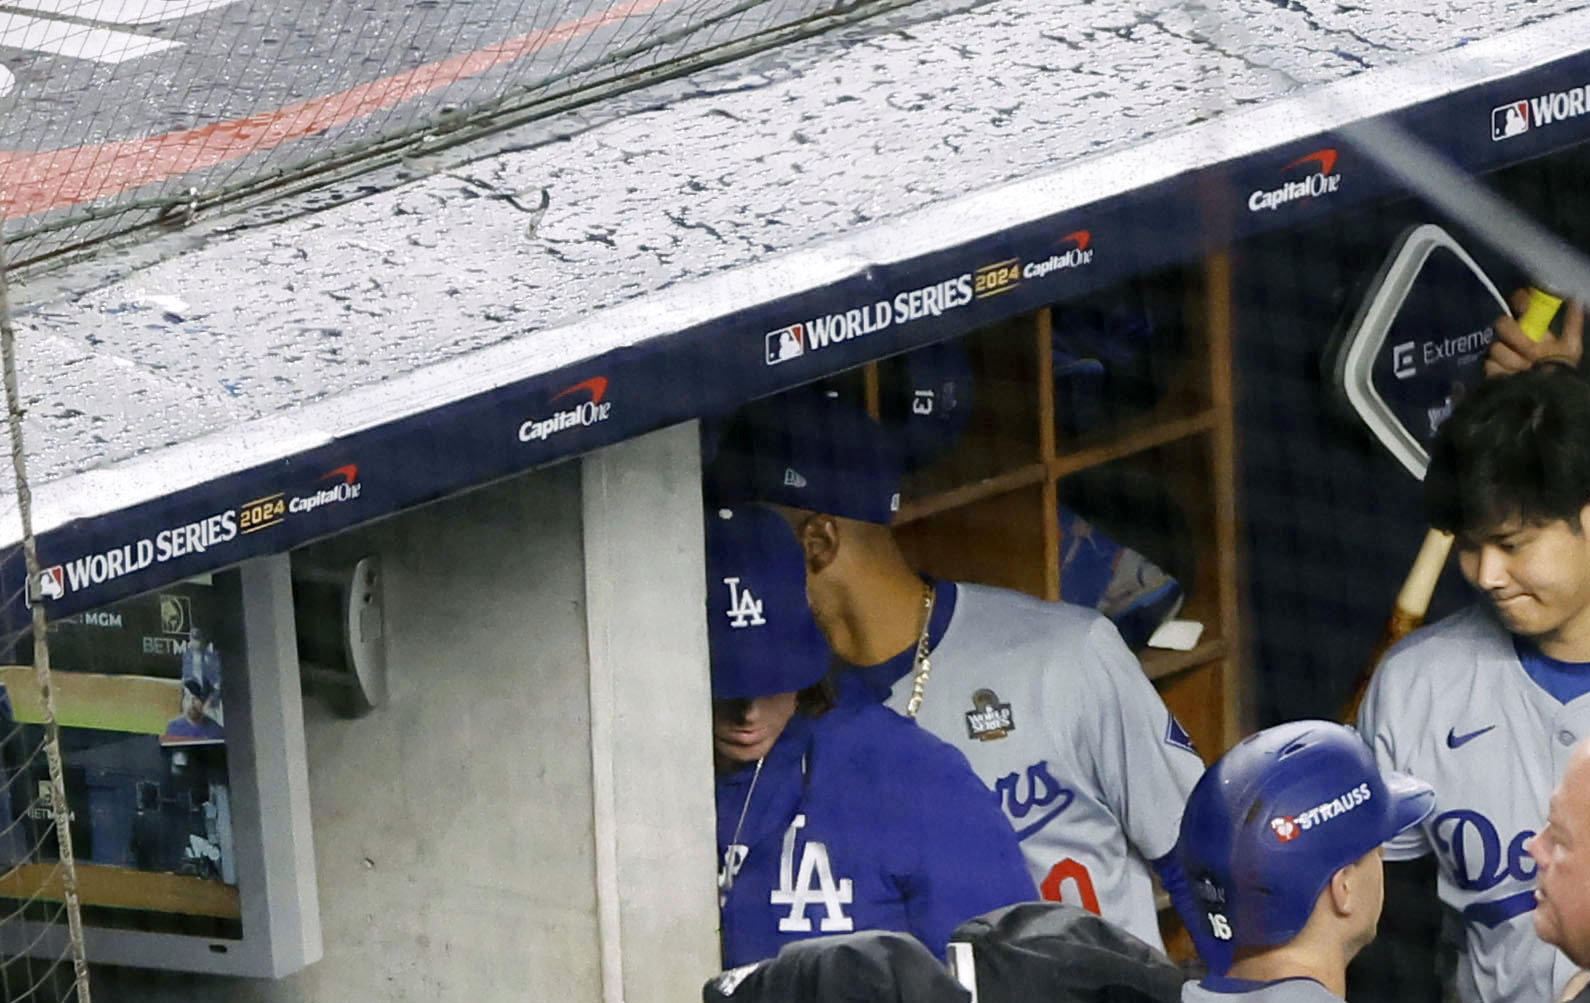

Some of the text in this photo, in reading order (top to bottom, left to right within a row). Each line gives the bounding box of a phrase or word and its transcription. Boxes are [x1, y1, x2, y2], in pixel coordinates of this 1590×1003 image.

[806, 300, 892, 350] WORLD
[895, 273, 973, 323] SERIES
[975, 265, 1020, 291] 2024
[1422, 326, 1494, 364] Extreme
[67, 539, 153, 592] WORLD
[156, 509, 238, 563] SERIES
[240, 499, 286, 529] 2024
[724, 577, 766, 627] LA
[967, 706, 1011, 724] WORLD
[1300, 783, 1371, 830] STRAUSS
[770, 814, 854, 932] LA
[1207, 911, 1233, 940] 16
